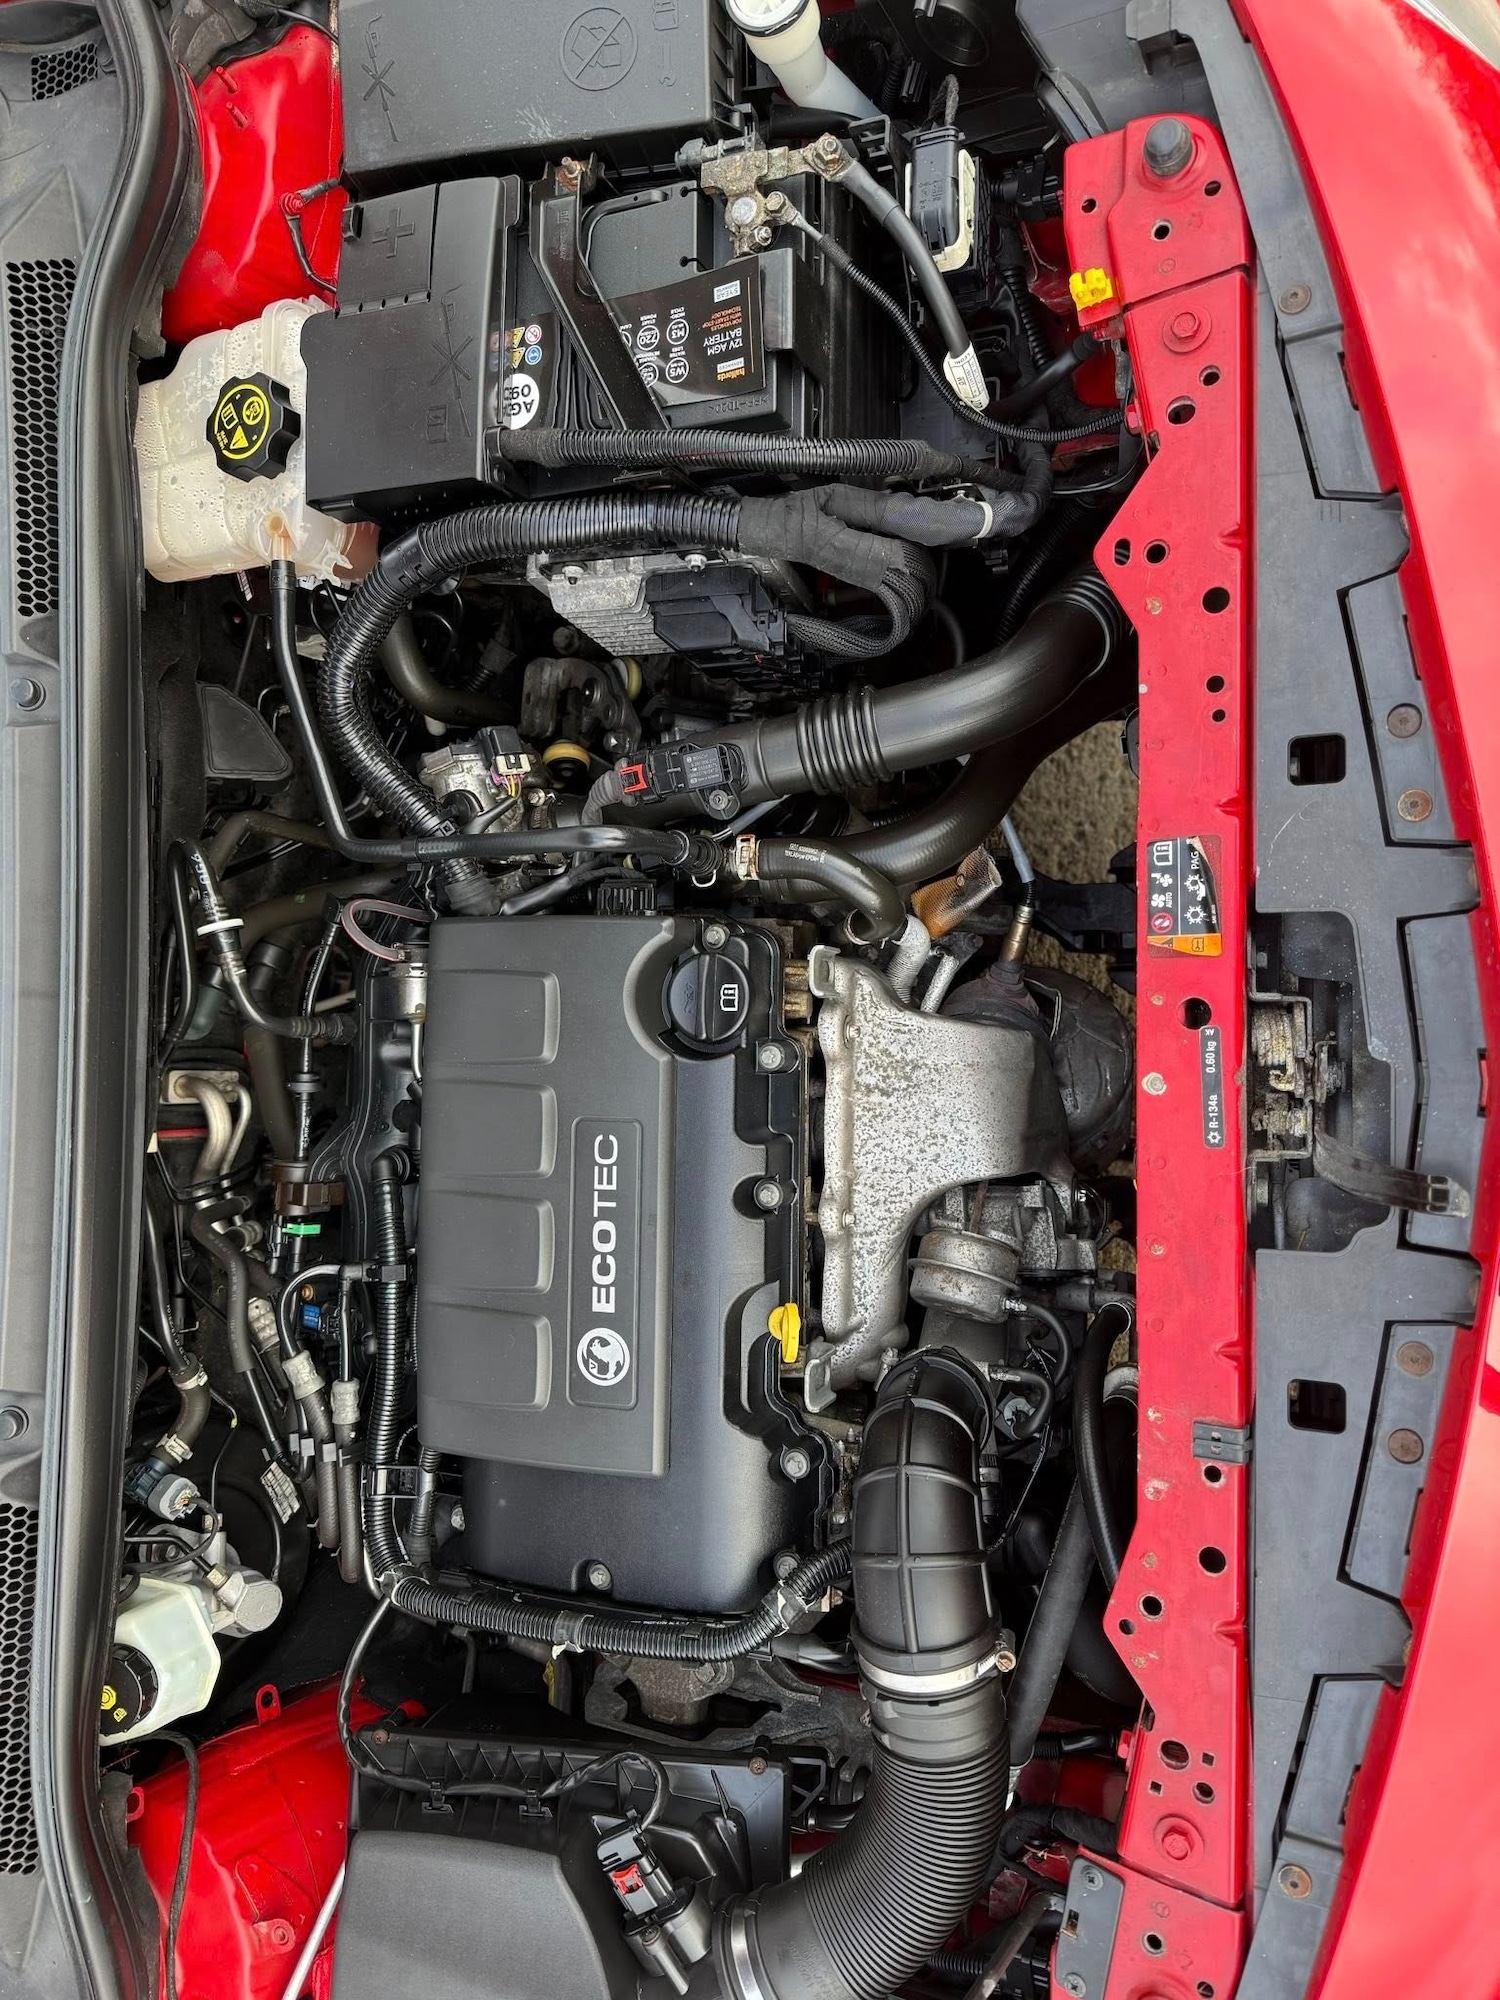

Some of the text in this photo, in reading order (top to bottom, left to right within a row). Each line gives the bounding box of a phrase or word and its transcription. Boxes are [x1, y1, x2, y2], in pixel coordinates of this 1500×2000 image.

[717, 290, 735, 300] YEAR
[640, 333, 657, 345] 720
[671, 327, 685, 339] M3
[703, 327, 743, 348] BATTERY
[707, 338, 743, 356] 12V AGM
[669, 366, 686, 378] W5
[717, 368, 745, 382] halfords
[1191, 850, 1200, 870] PAG
[1165, 892, 1173, 908] AUTO
[1205, 1041, 1219, 1129] R-134a 0.60 kg
[592, 1134, 619, 1314] ECOTEC
